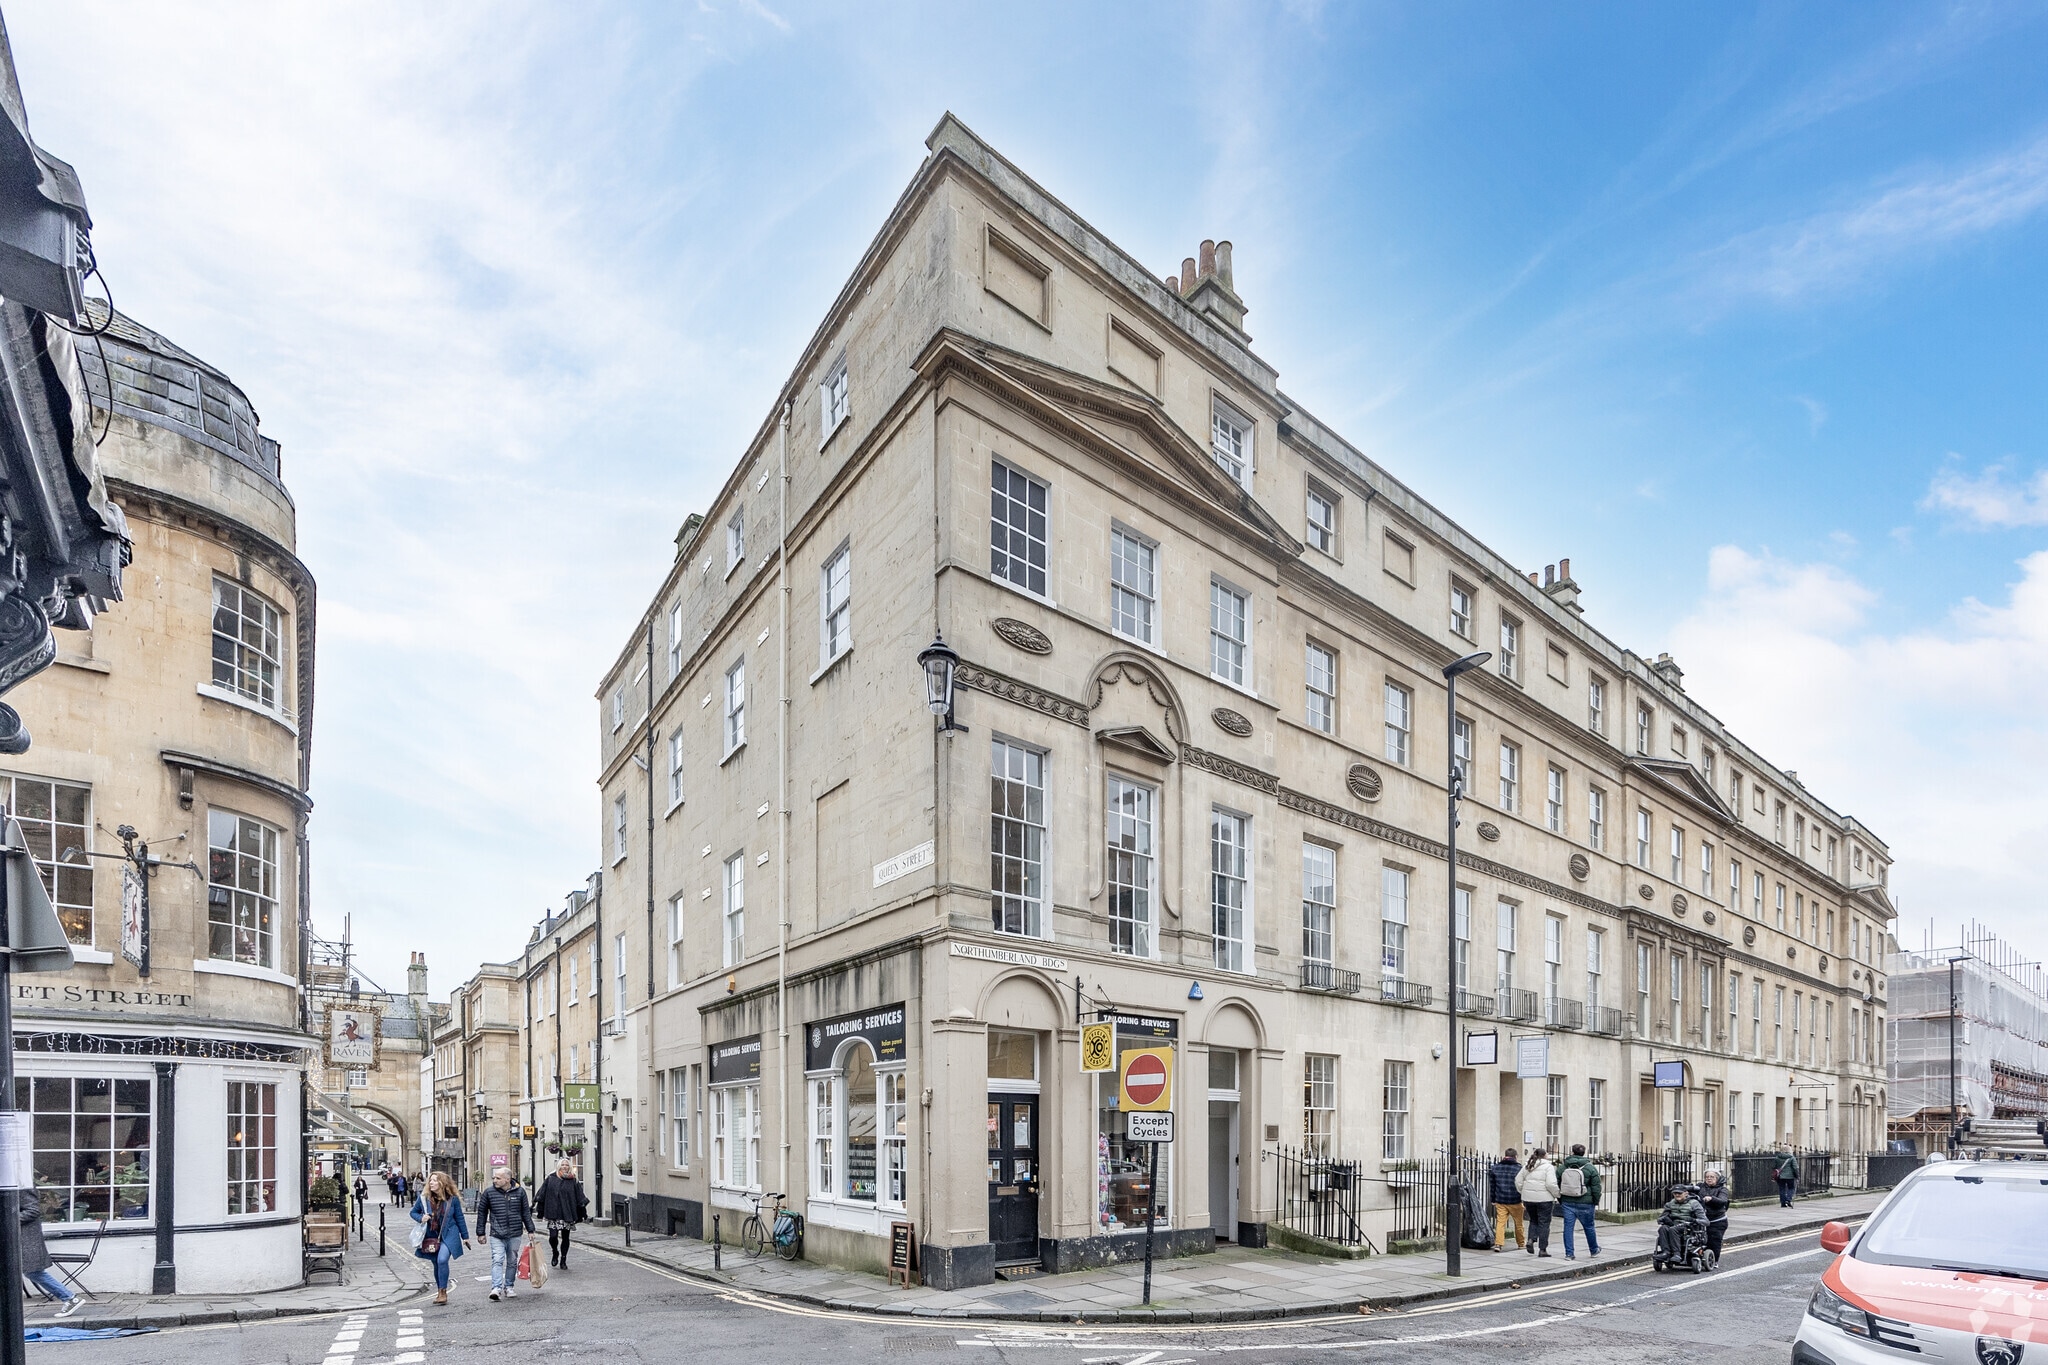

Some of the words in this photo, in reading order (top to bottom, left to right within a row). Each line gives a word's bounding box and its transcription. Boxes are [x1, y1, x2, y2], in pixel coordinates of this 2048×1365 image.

[878, 863, 899, 880] QUEEN
[902, 850, 926, 869] STREET
[954, 944, 1037, 965] NORTHUMBERLAND
[64, 985, 192, 1007] STREET
[826, 1018, 863, 1037] TAILORING
[865, 1010, 903, 1030] SERVICES
[1103, 1014, 1139, 1026] TALORING
[1141, 1018, 1170, 1028] SERVICES
[333, 1047, 371, 1059] RAVEN
[720, 1046, 741, 1058] TAILORING
[741, 1041, 760, 1054] SERVICES
[569, 1102, 595, 1110] HOTEL
[1132, 1115, 1169, 1126] Except
[1133, 1126, 1168, 1138] Cycles
[865, 1183, 876, 1193] SHO
[1901, 1280, 2048, 1300] www.mfs-lt
[1980, 1339, 2019, 1349] PEUGEOT
